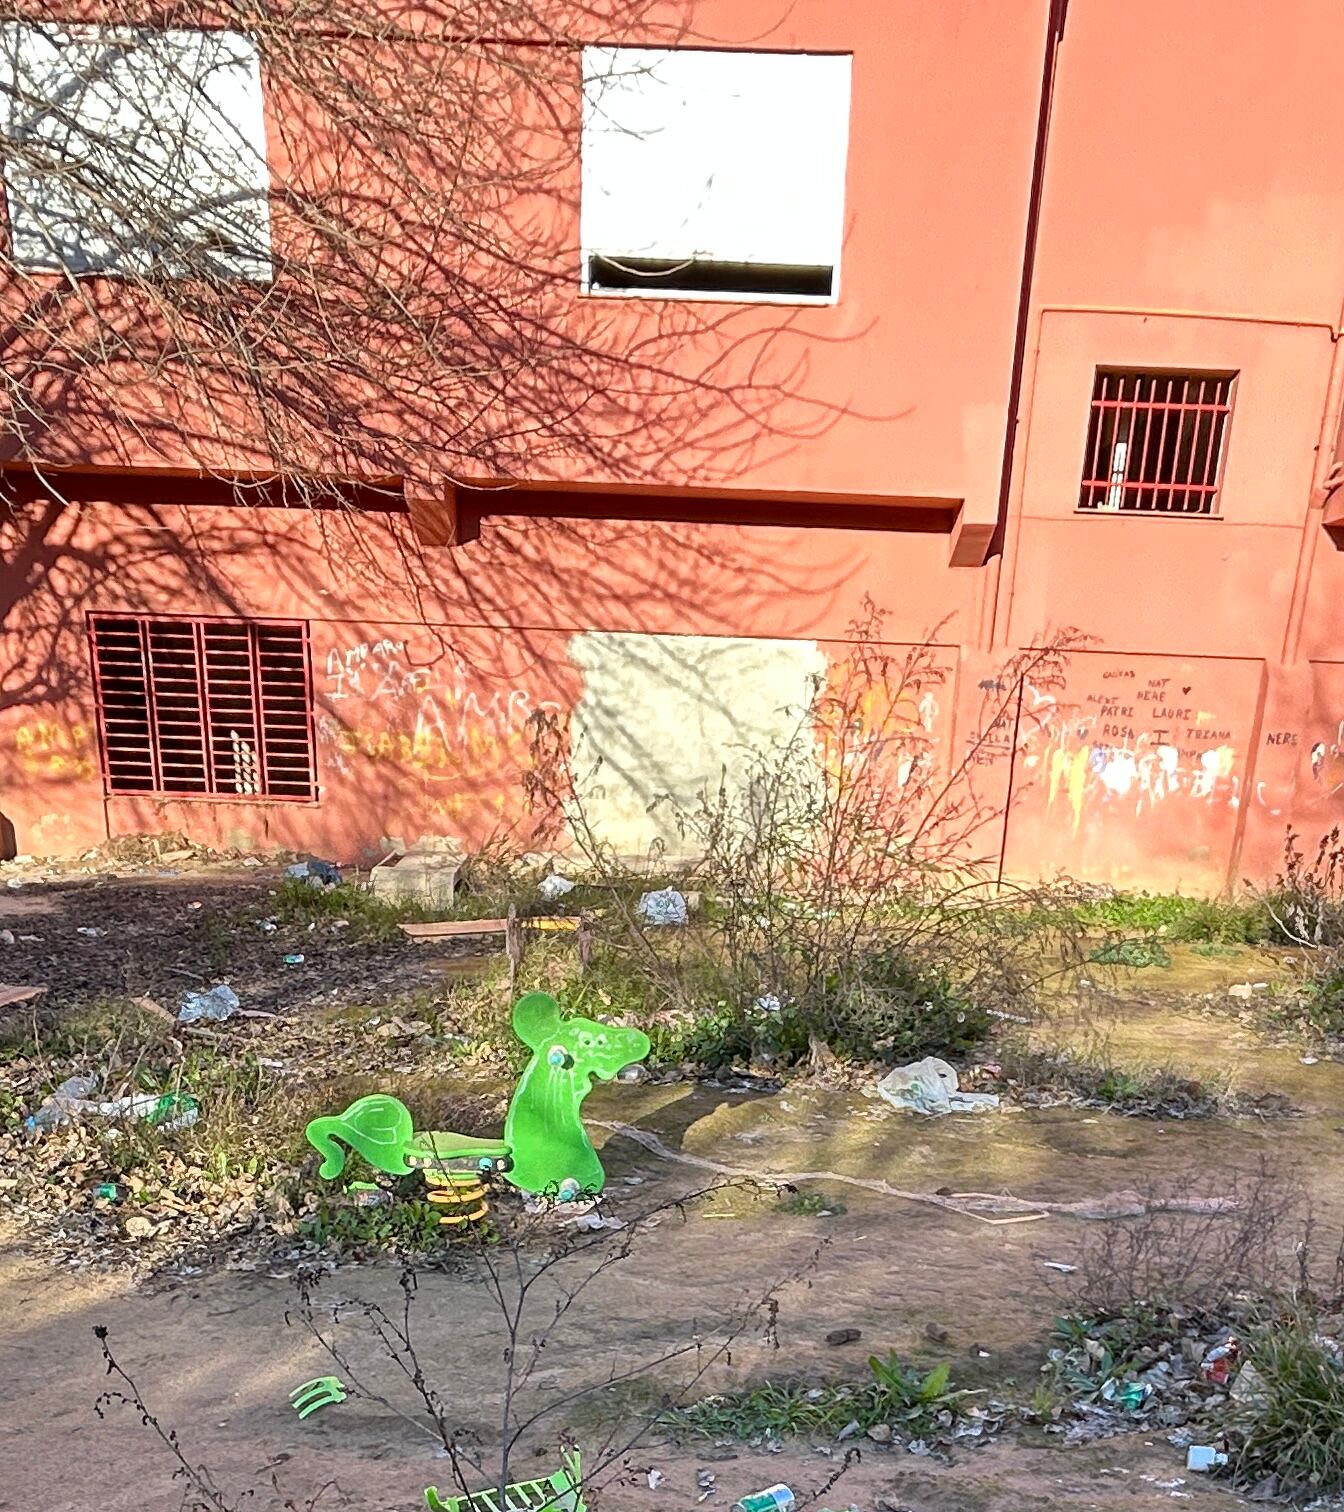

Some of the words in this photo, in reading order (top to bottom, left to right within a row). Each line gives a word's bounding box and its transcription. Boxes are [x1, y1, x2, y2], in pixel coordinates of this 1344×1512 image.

[1100, 705, 1134, 718] PATRI
[1152, 707, 1192, 721] LAURI
[1102, 723, 1135, 740] ROSA
